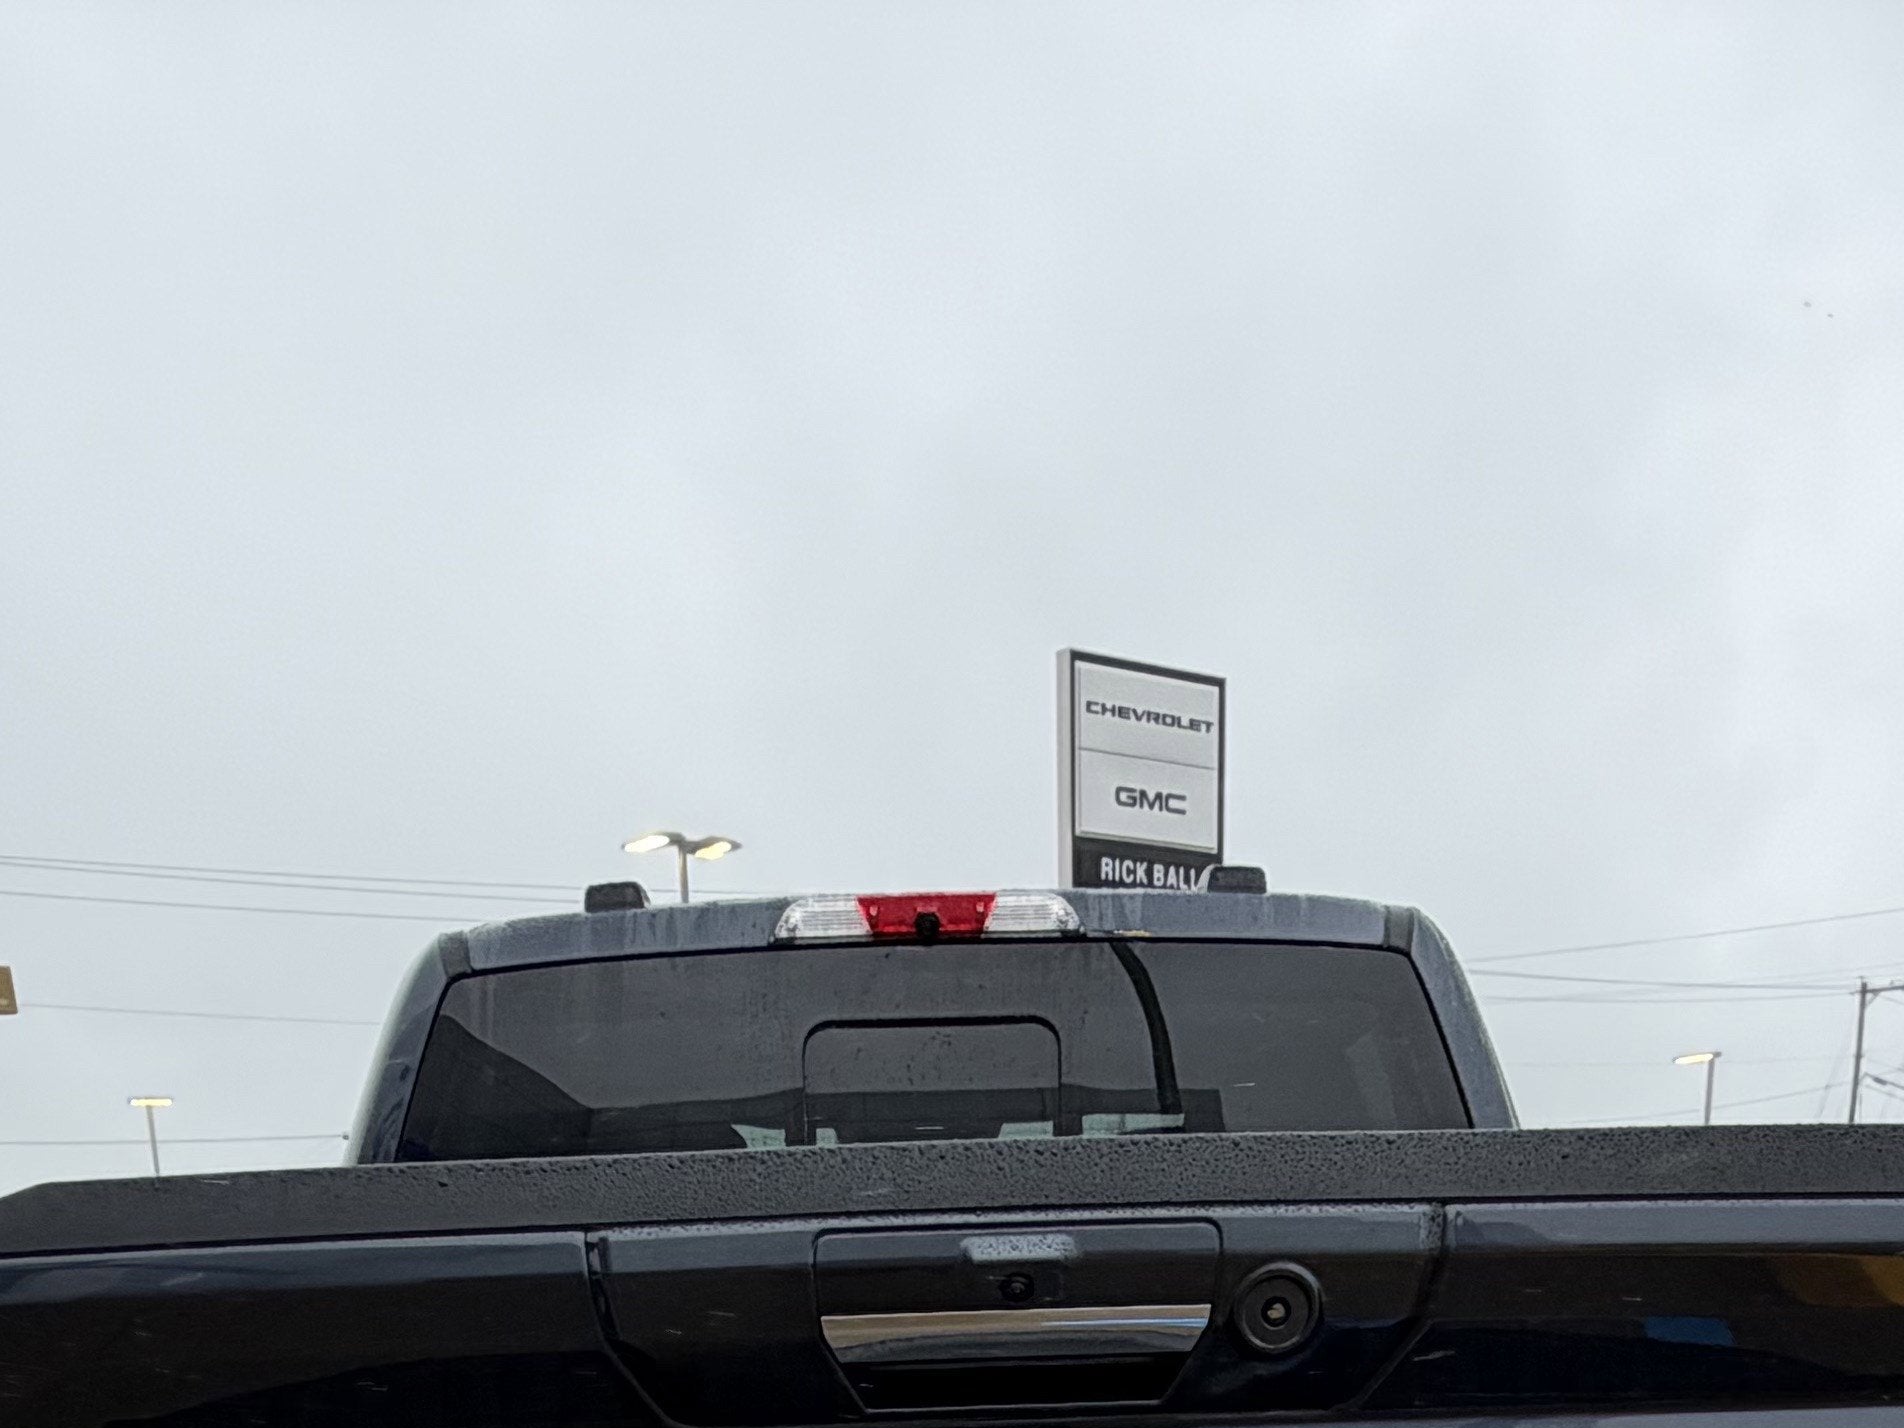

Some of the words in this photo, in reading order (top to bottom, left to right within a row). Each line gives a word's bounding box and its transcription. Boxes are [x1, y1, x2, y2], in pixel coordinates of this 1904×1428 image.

[1085, 700, 1215, 734] CHEVROLET
[1114, 785, 1188, 816] GMC
[1100, 856, 1148, 886] RICK
[1153, 863, 1199, 893] BALL
